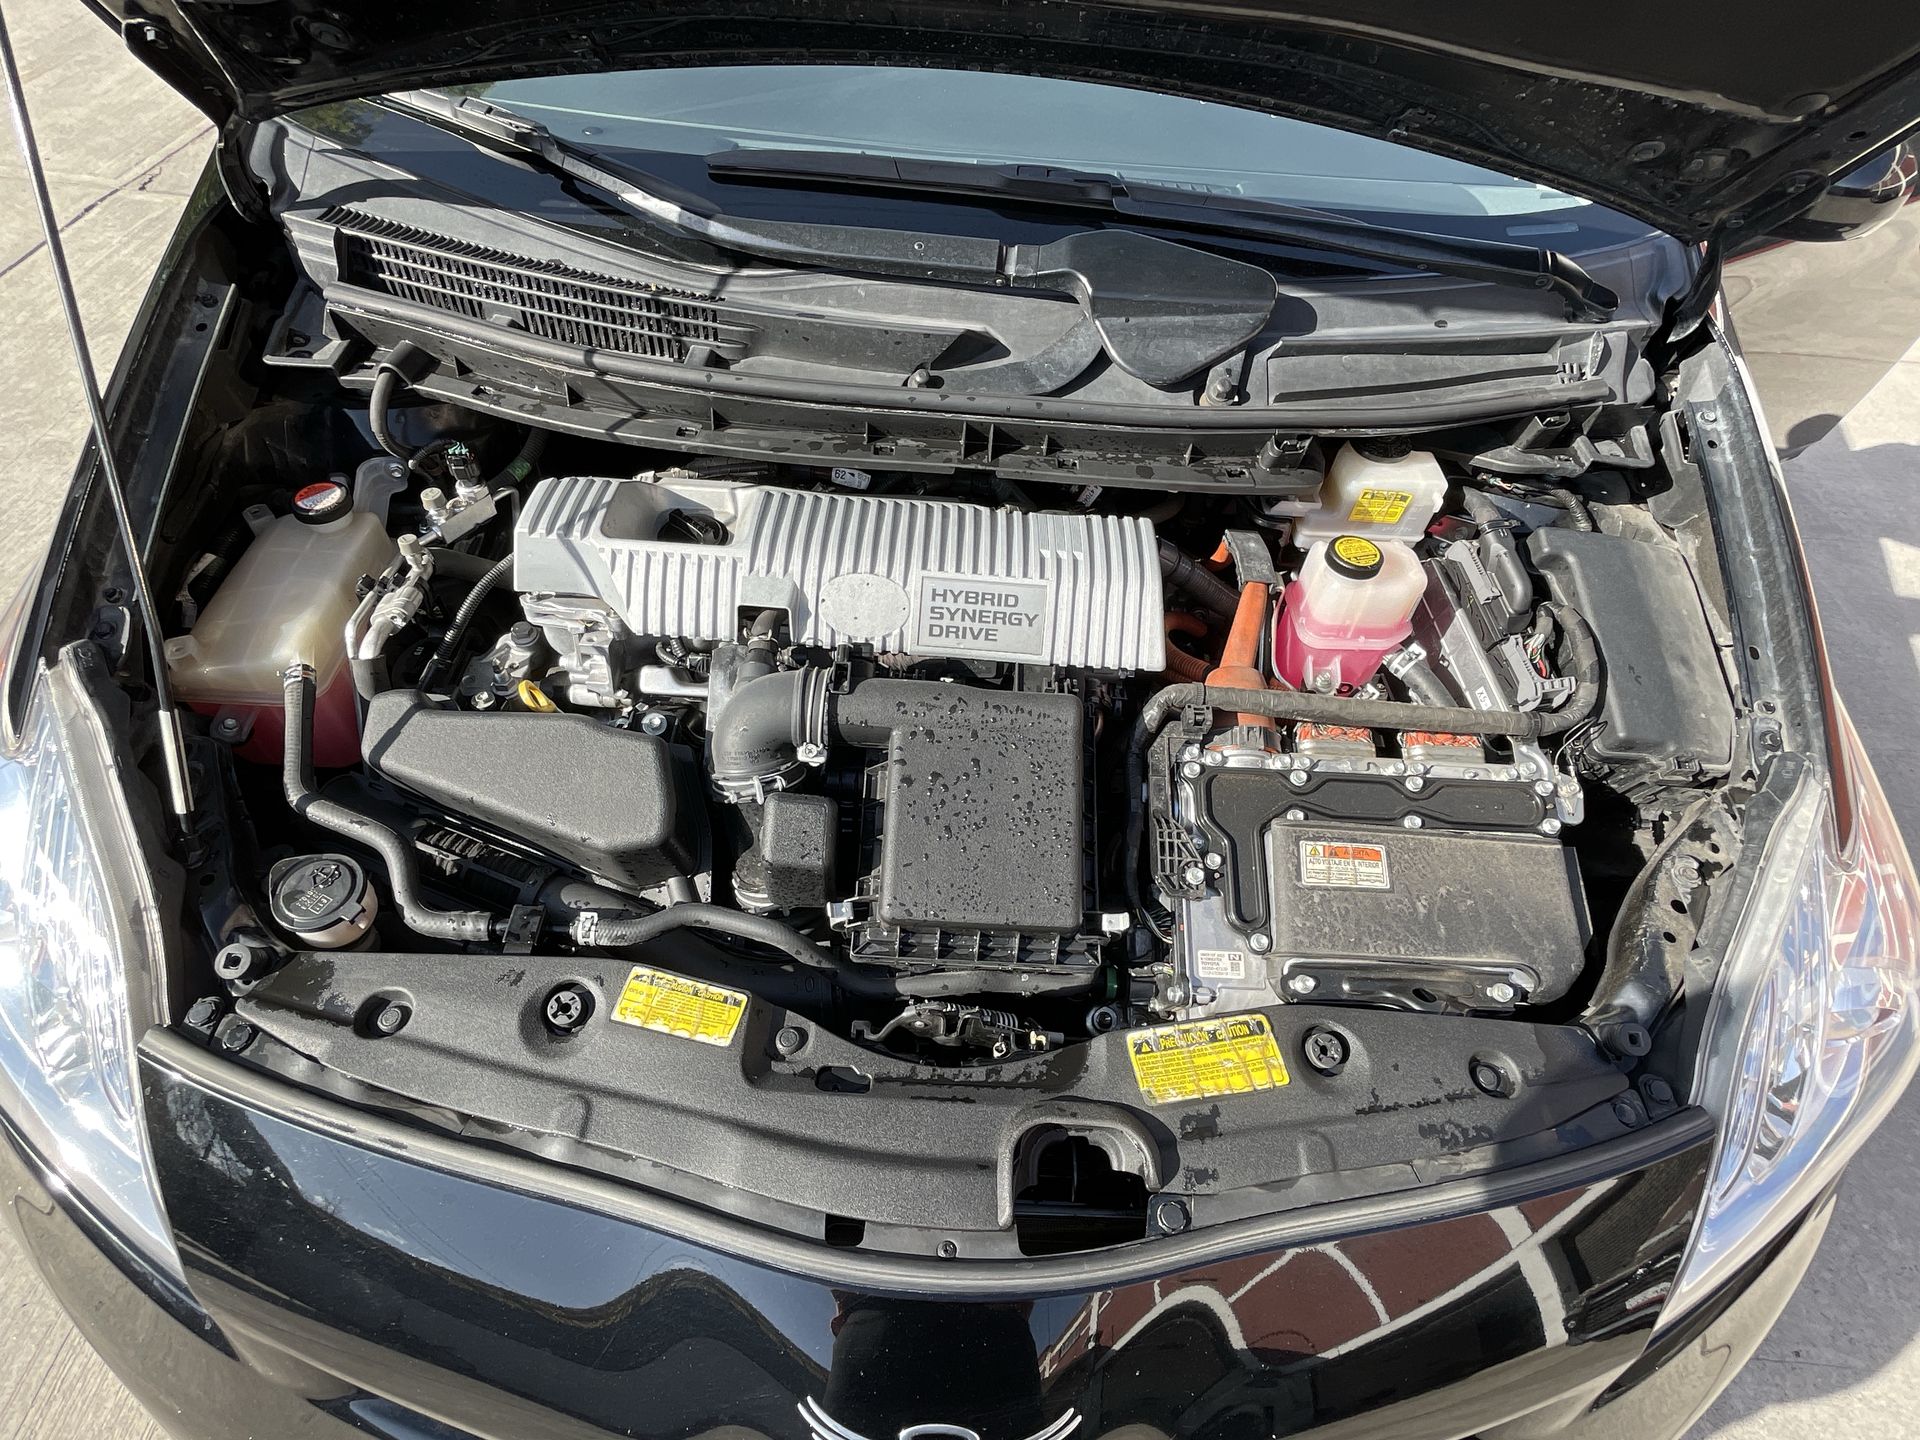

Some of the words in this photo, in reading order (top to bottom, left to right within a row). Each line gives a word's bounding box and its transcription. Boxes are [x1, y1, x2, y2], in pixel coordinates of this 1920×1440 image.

[834, 469, 847, 480] 62
[931, 588, 1019, 608] HYBRID
[929, 606, 1040, 627] SYNERGY
[928, 623, 999, 642] DRIVE
[1358, 861, 1380, 869] INTERIOR
[1216, 1023, 1250, 1041] CAUTION
